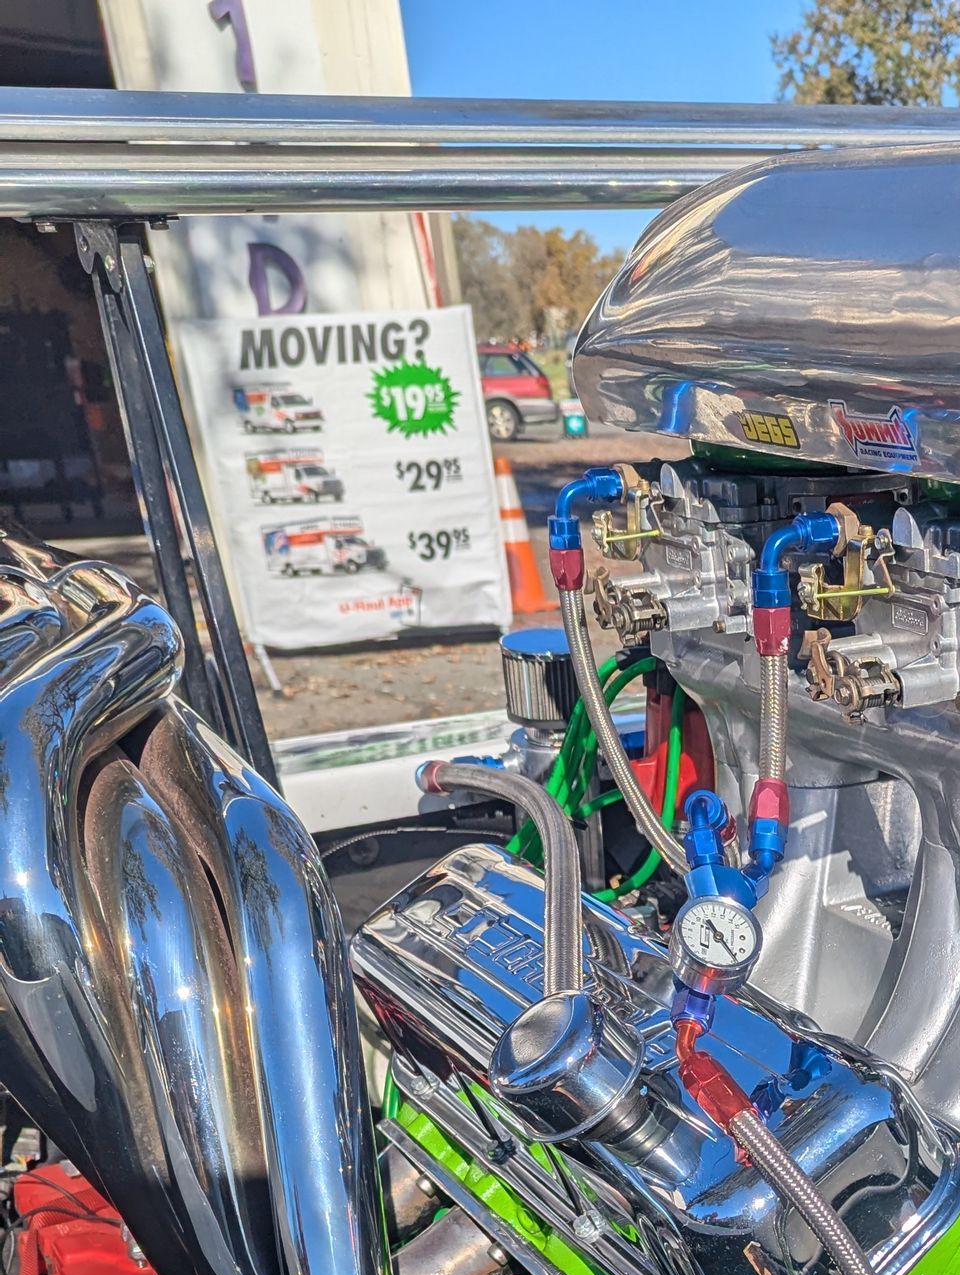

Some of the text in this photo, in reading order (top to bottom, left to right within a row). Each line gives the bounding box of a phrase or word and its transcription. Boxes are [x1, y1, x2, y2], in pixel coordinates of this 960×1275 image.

[240, 318, 430, 370] MOVING?
[742, 411, 798, 447] JEGS
[830, 403, 912, 450] SUMMIT
